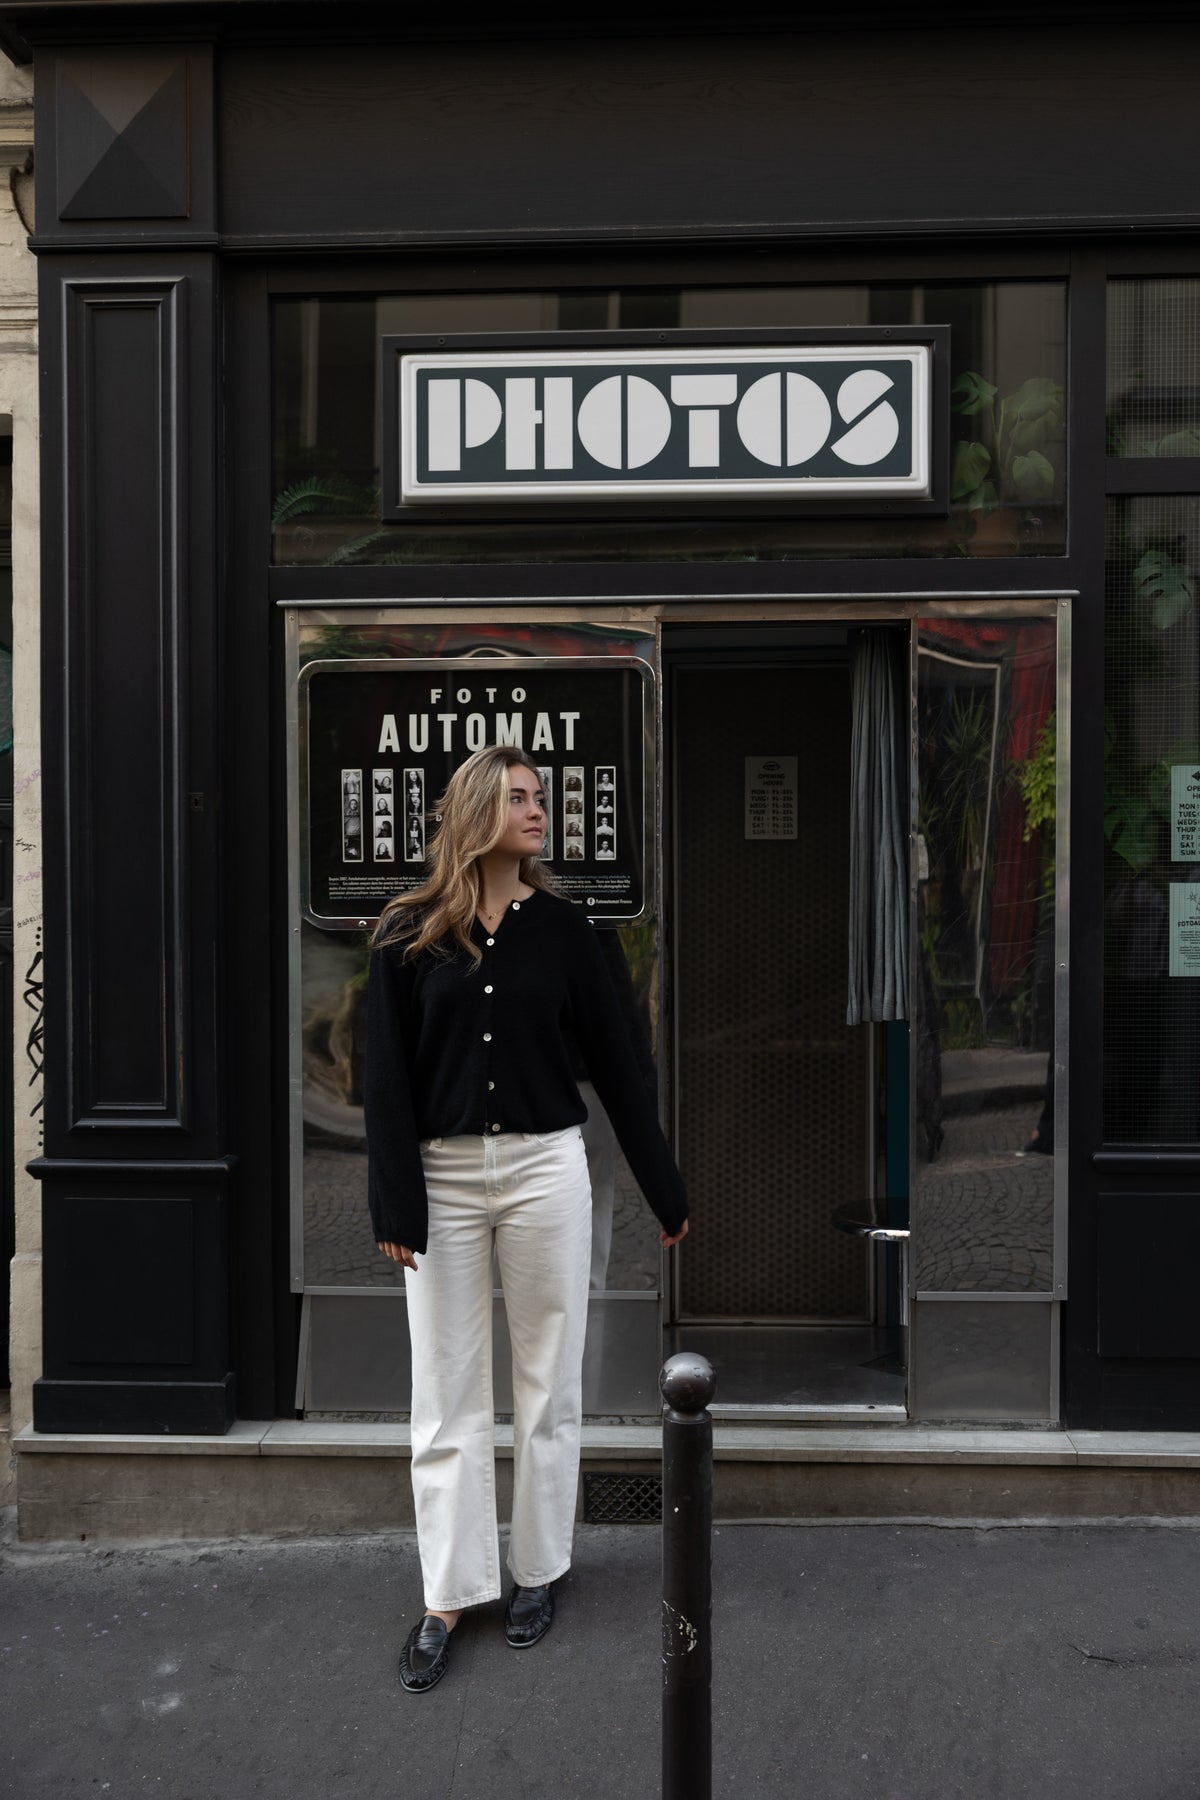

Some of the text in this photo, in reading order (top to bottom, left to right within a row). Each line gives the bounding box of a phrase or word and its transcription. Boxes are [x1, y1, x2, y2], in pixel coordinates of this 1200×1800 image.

[428, 368, 900, 472] PHOTOS
[430, 687, 527, 704] FOTO
[377, 711, 581, 753] AUTOMAT
